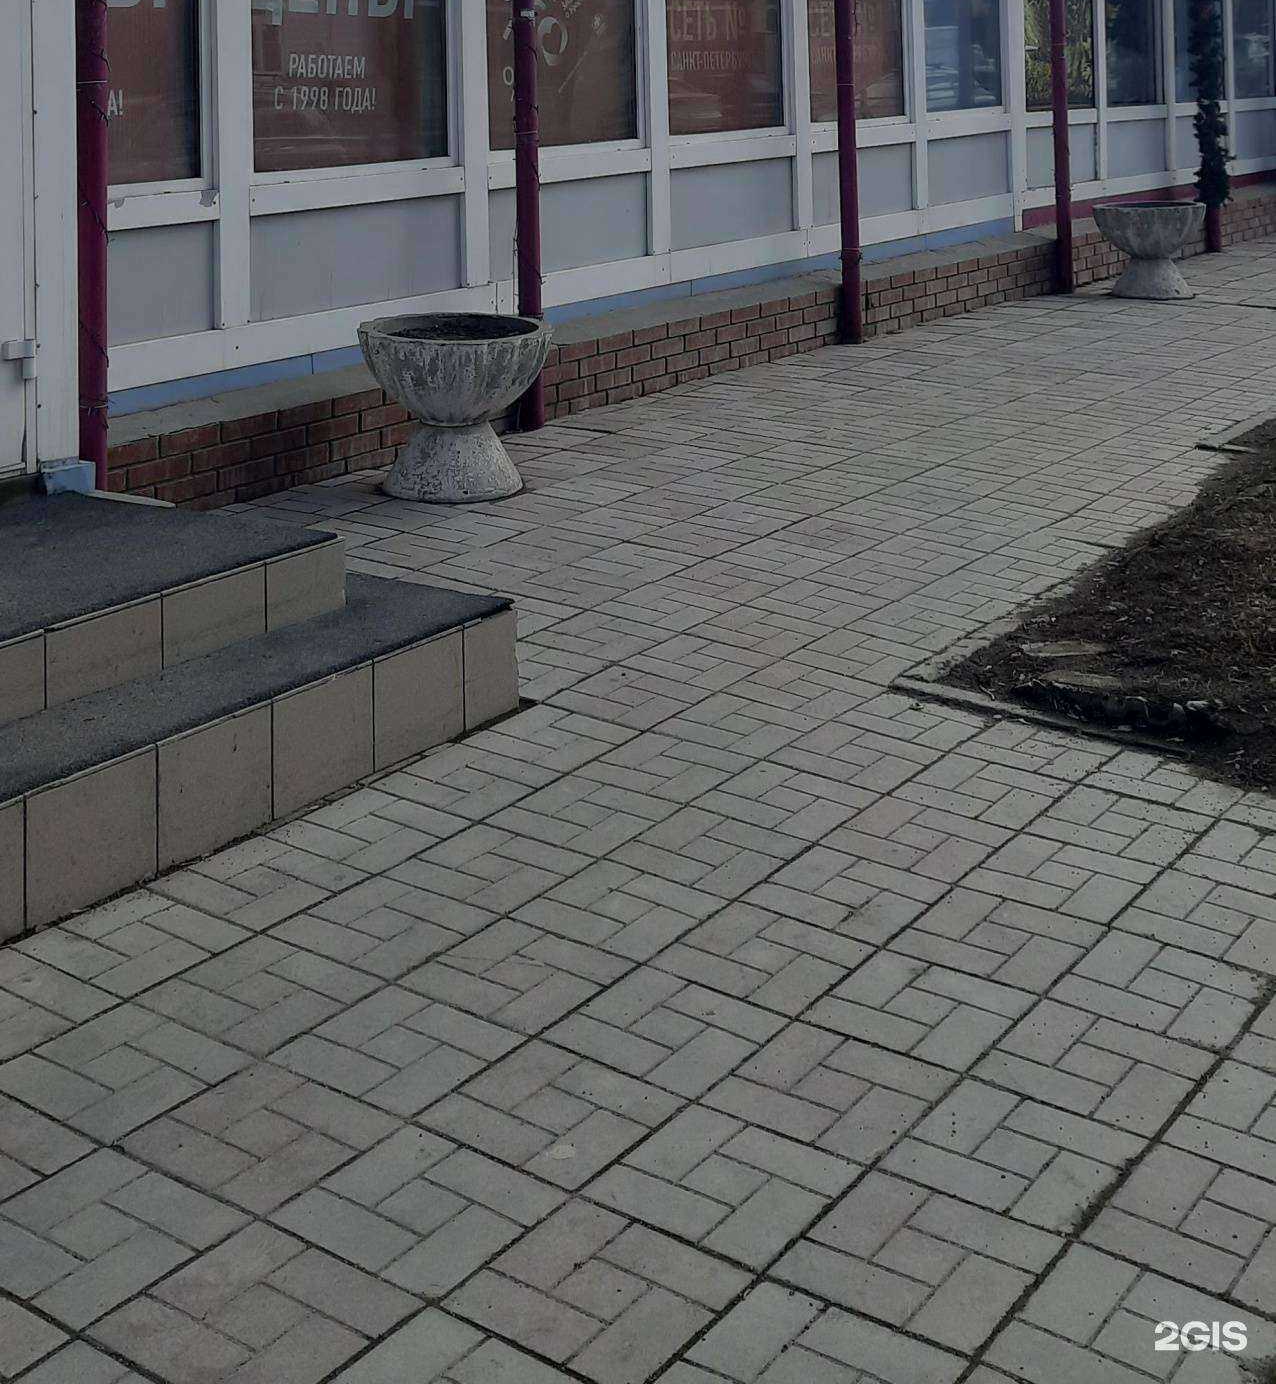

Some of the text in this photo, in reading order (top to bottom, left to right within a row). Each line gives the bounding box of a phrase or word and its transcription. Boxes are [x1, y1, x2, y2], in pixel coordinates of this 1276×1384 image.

[288, 53, 367, 81] РАБОТАЕМ
[273, 85, 377, 115] С 1998 ГОДА!
